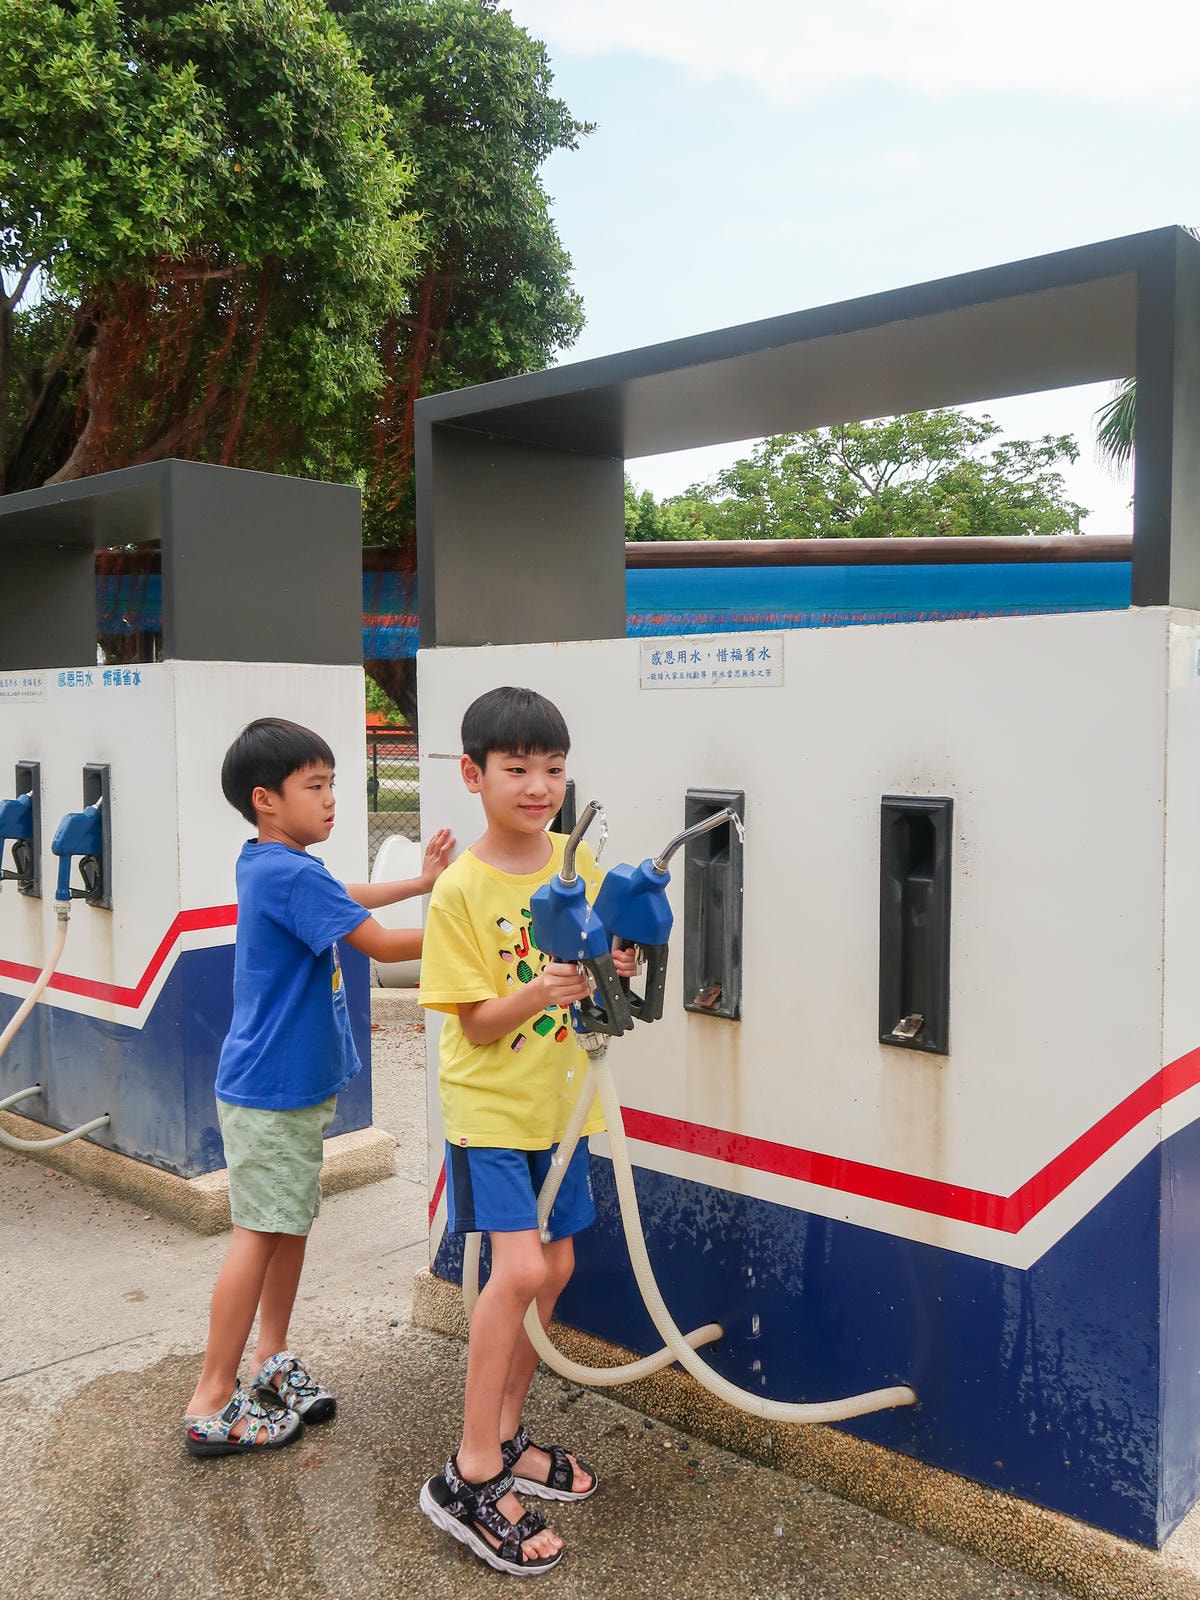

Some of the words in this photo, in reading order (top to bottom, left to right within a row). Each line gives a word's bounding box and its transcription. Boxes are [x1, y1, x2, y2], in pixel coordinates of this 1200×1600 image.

[651, 646, 771, 666] 感恩用水，惜福省水
[58, 670, 94, 688] 感恩用水
[102, 668, 142, 687] 惜福省水
